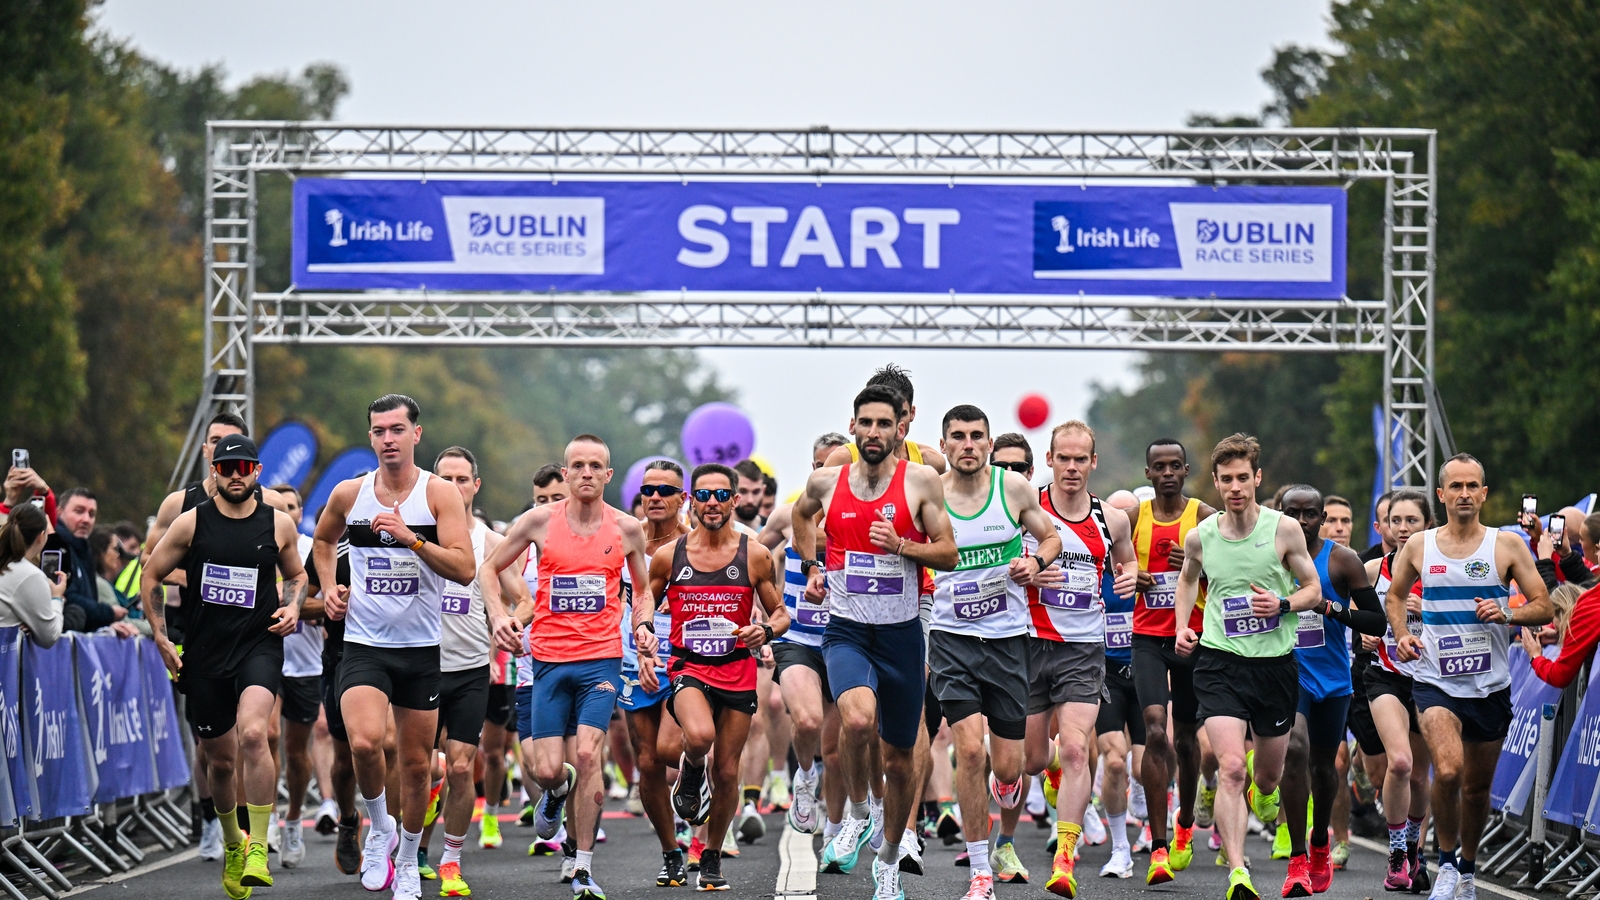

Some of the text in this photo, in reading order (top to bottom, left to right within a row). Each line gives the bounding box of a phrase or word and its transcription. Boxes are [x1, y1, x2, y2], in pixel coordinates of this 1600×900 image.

[350, 220, 433, 241] Irish Life
[470, 212, 586, 237] DUBLIN
[1196, 219, 1314, 244] DUBLIN
[676, 204, 960, 268] START
[1077, 227, 1160, 248] Irish Life
[469, 242, 586, 257] RACE SERIES
[1196, 249, 1314, 263] RACE SERIES
[957, 546, 1004, 567] AHENY
[1057, 551, 1099, 564] DRUNNERS
[1061, 560, 1076, 570] A.C.
[371, 579, 412, 593] 8207
[868, 578, 878, 593] 2
[208, 587, 246, 604] 5103
[679, 592, 743, 601] PUROSANGUE
[1057, 592, 1076, 606] 10
[1150, 593, 1175, 606] 799
[442, 597, 461, 612] 13
[559, 598, 596, 610] 8132
[681, 603, 738, 612] ATHLETICS
[960, 598, 1000, 617] 4599
[811, 612, 829, 624] 43
[1236, 617, 1268, 632] 881
[1112, 632, 1132, 644] 413
[693, 640, 727, 653] 5611
[1446, 656, 1483, 673] 6197
[1510, 708, 1538, 758] Life
